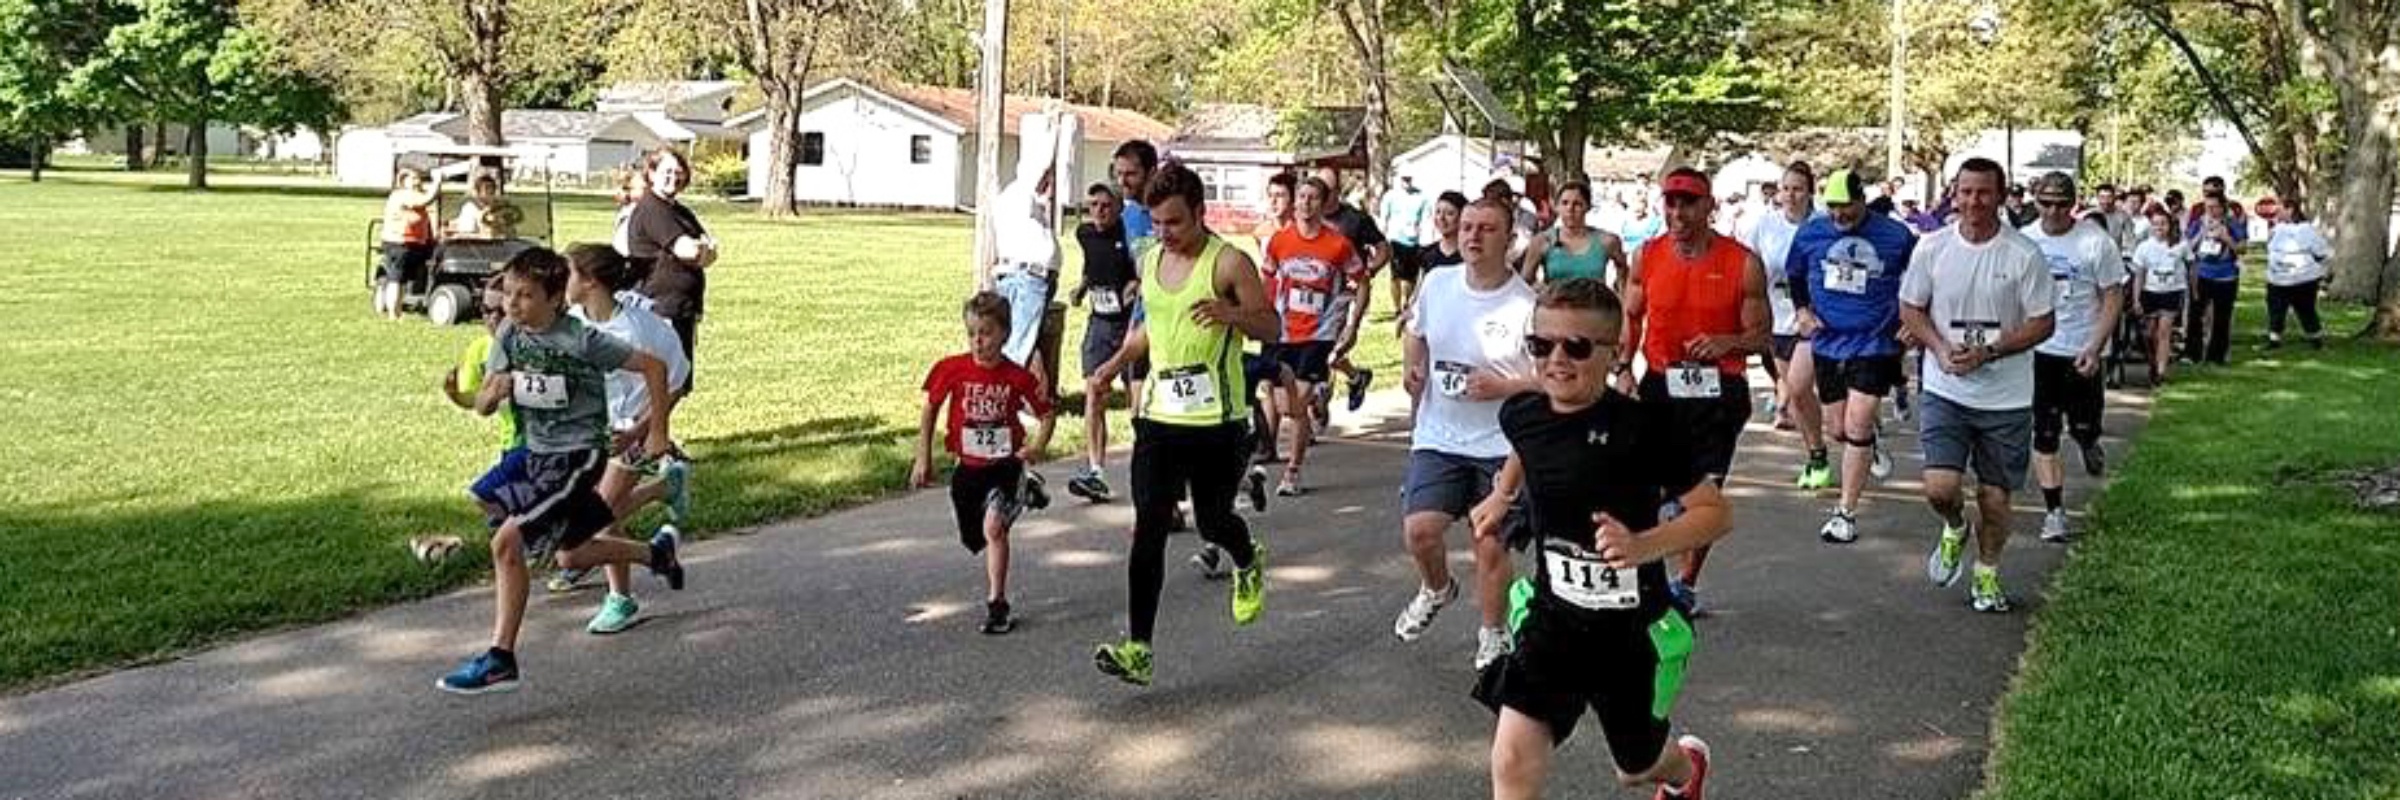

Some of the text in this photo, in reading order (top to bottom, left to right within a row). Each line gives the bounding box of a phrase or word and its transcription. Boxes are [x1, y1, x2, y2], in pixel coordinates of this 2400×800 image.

[1963, 328, 1986, 346] 66
[961, 380, 1011, 400] TEAM
[1172, 378, 1197, 398] 42
[1561, 560, 1621, 590] 114
